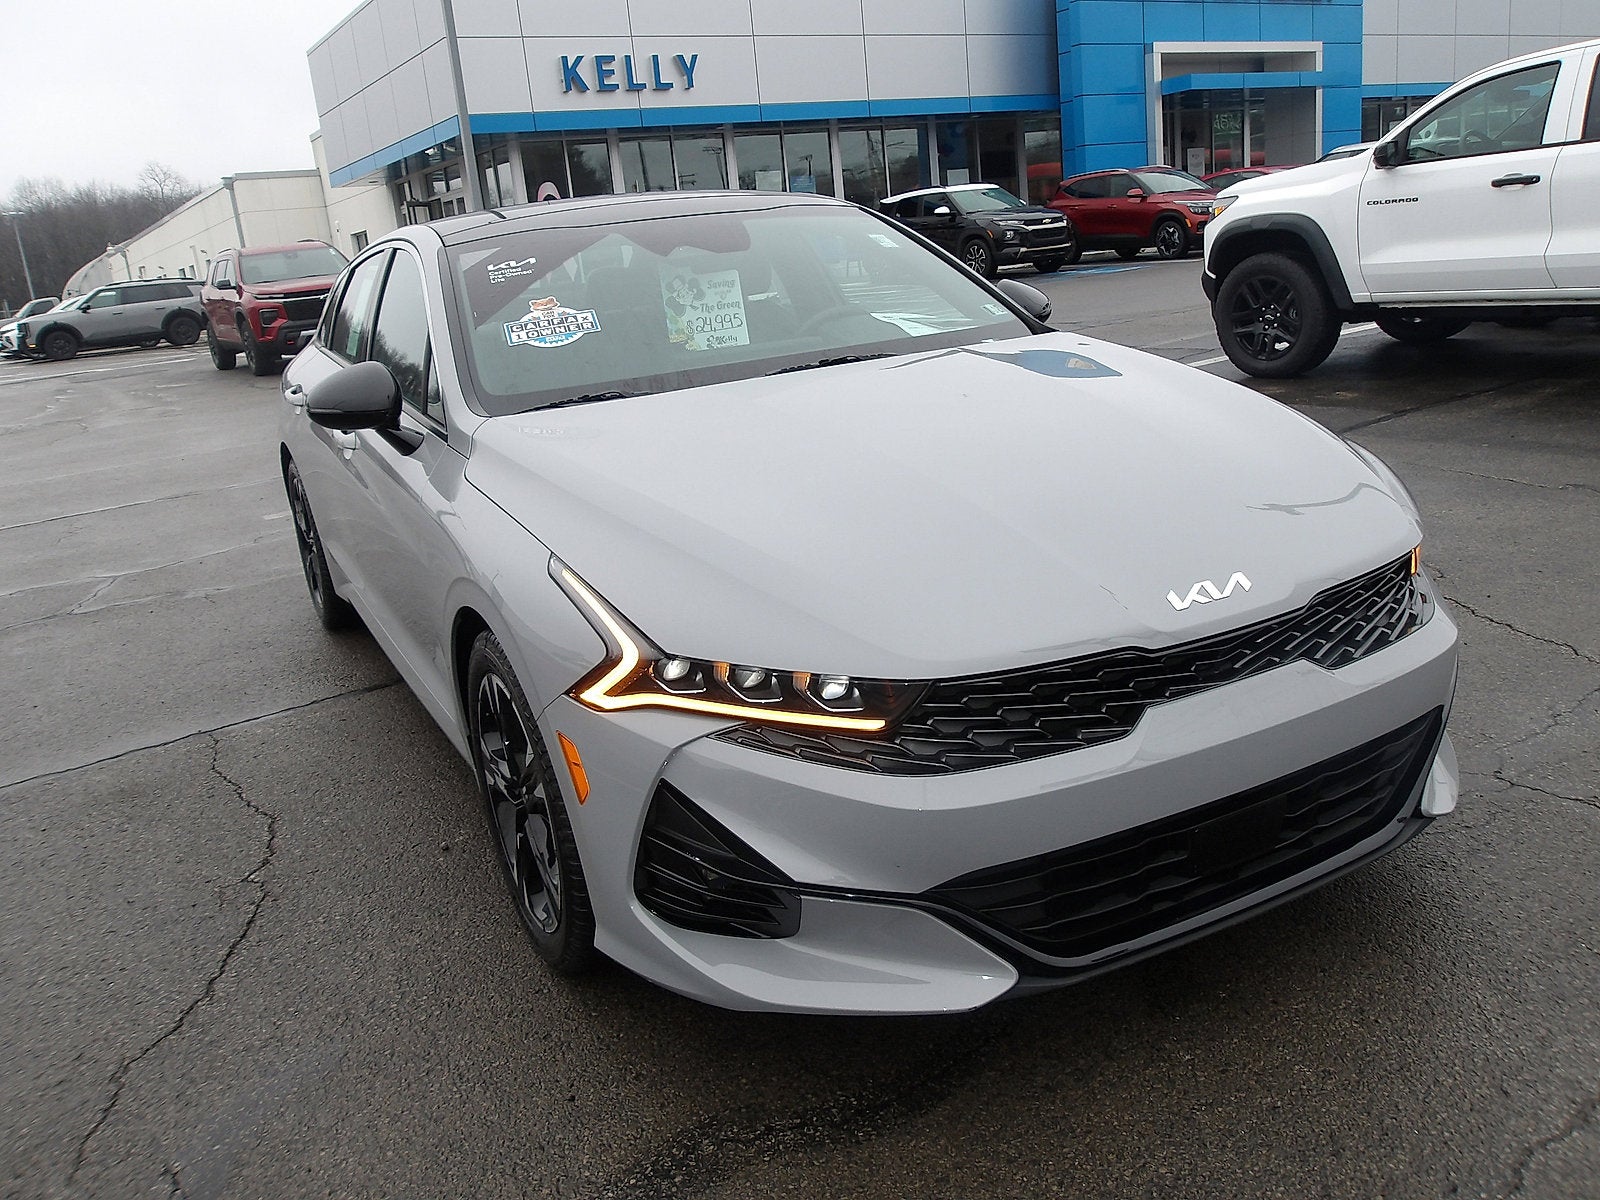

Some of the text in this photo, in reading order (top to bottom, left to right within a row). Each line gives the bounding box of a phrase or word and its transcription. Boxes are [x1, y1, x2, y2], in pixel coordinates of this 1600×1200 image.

[560, 54, 699, 93] KELLY
[1366, 197, 1418, 205] COLORADO
[707, 279, 735, 289] Saving
[699, 300, 742, 313] The Green
[511, 315, 590, 332] CARFAX
[1166, 571, 1252, 611] KIA
